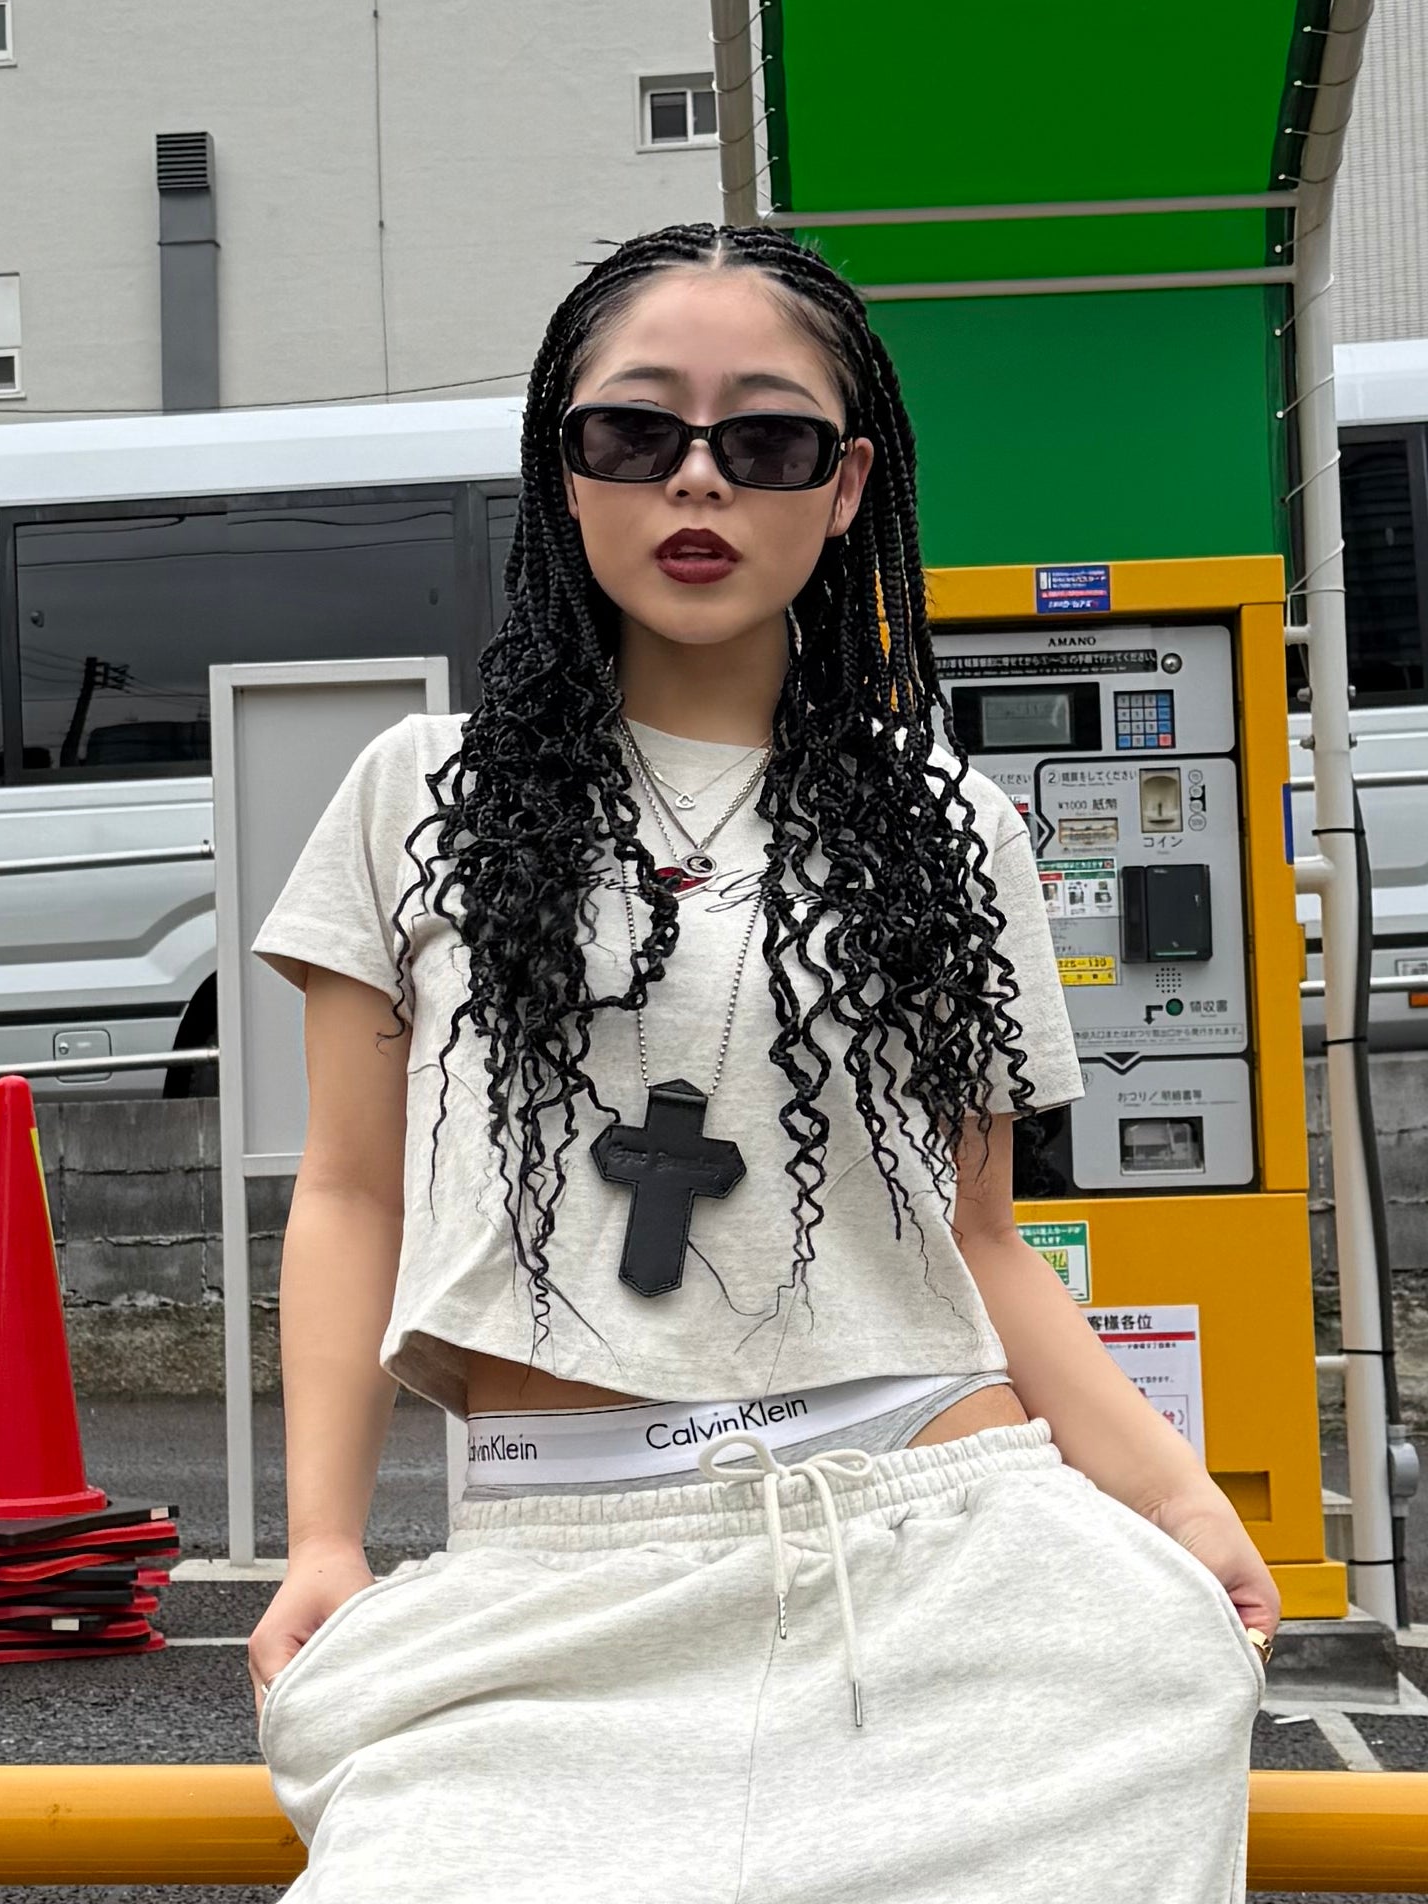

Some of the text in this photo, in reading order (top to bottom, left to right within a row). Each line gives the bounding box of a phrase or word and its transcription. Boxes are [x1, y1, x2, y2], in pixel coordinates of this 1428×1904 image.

[1048, 637, 1097, 647] AMANO
[1143, 836, 1184, 848] コイン
